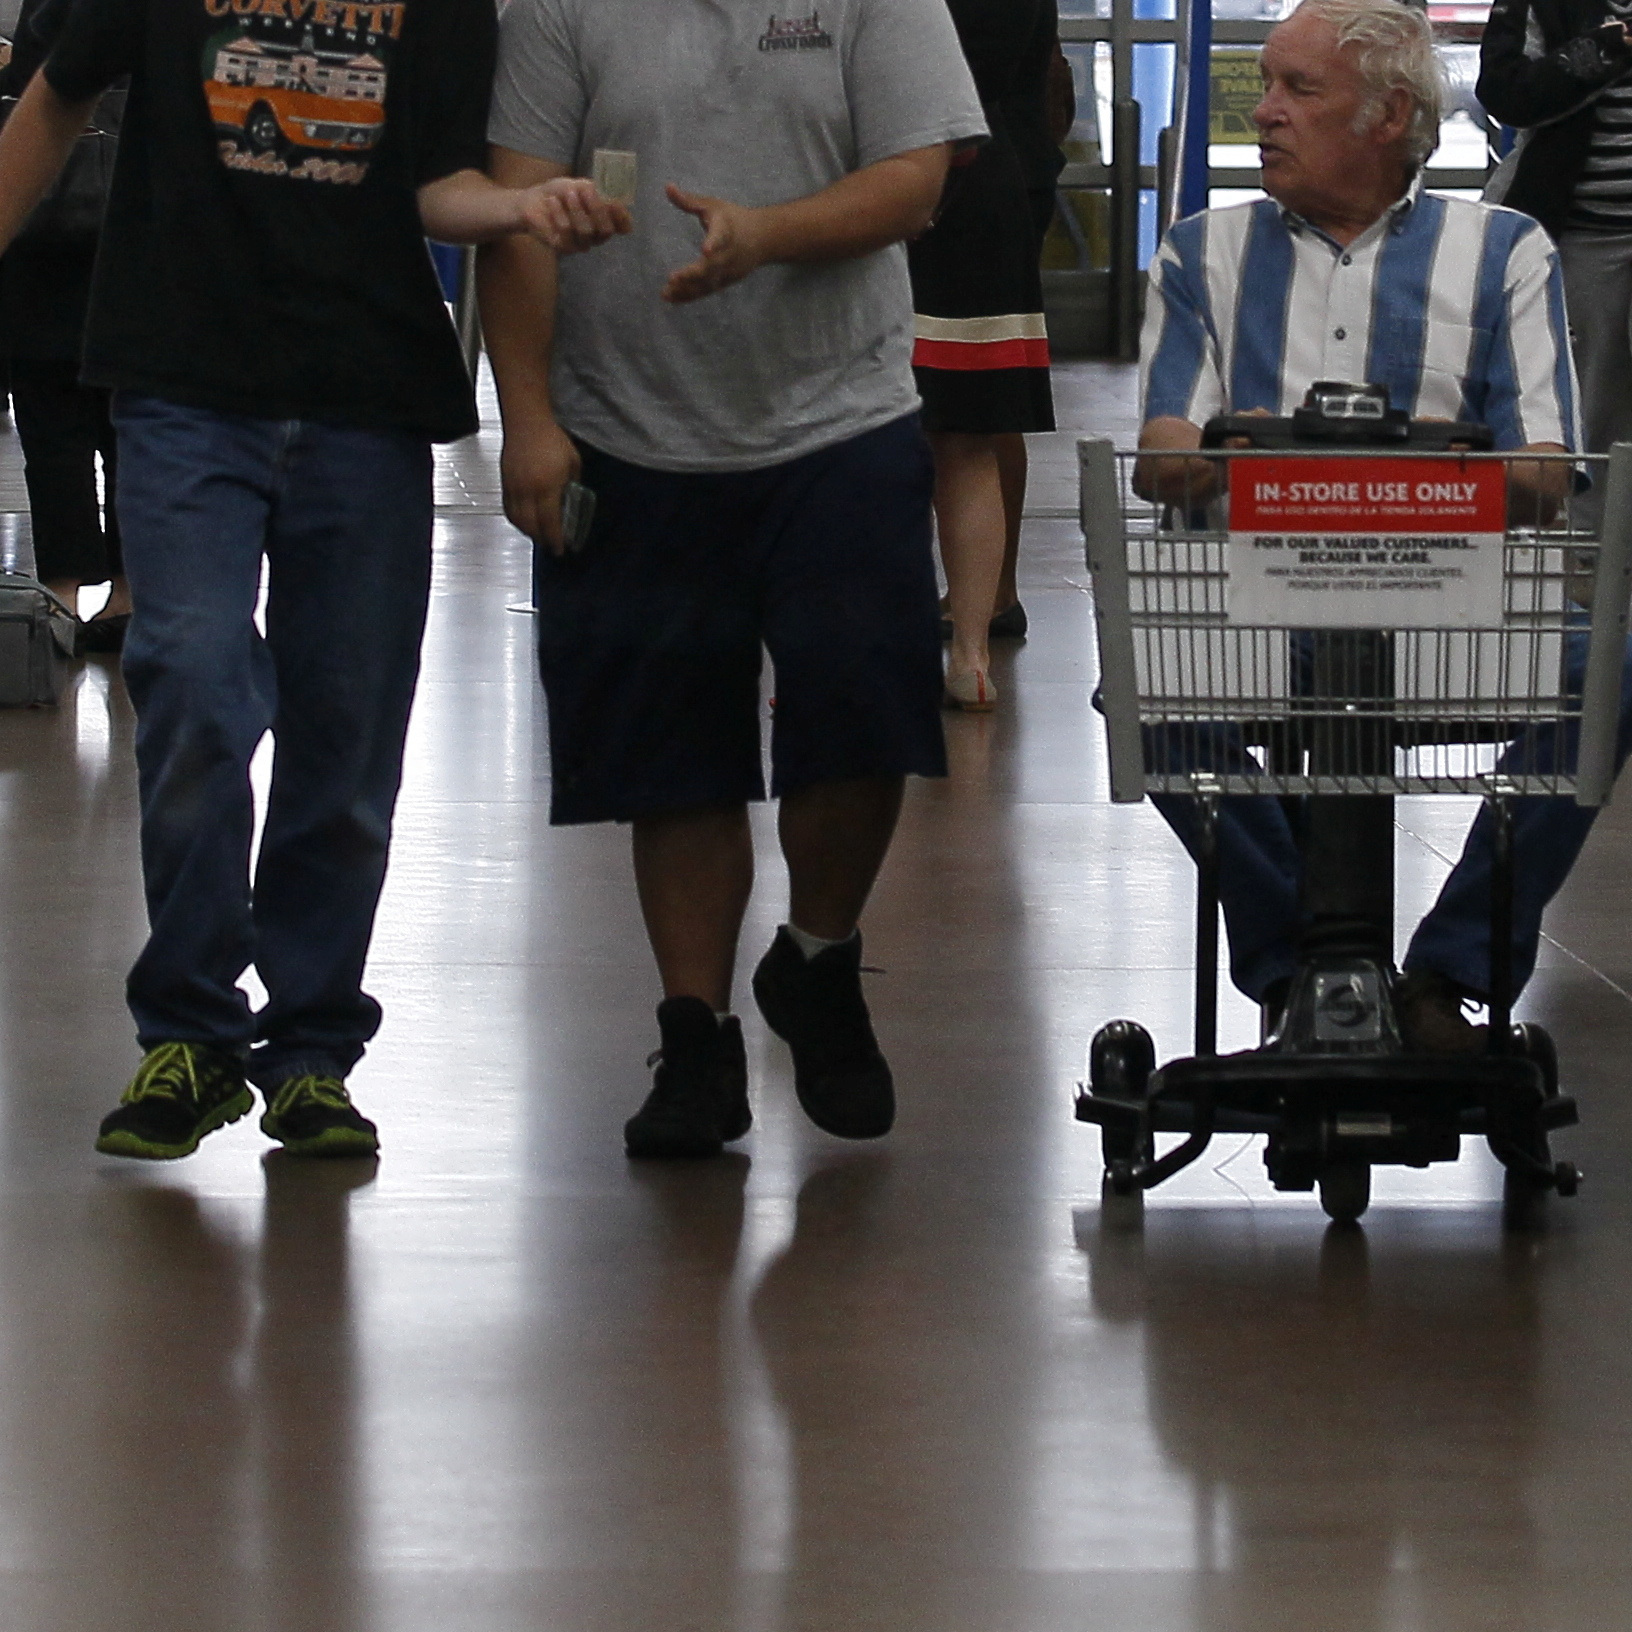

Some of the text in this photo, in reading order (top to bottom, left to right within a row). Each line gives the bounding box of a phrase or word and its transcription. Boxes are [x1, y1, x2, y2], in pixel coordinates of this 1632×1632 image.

[1253, 482, 1478, 502] IN-STORE USE ONLY
[1254, 536, 1283, 549] FOR
[1286, 536, 1319, 549] OUR
[1323, 536, 1380, 549] VALUED
[1298, 551, 1361, 564] BECAUSE
[1364, 551, 1387, 564] WE
